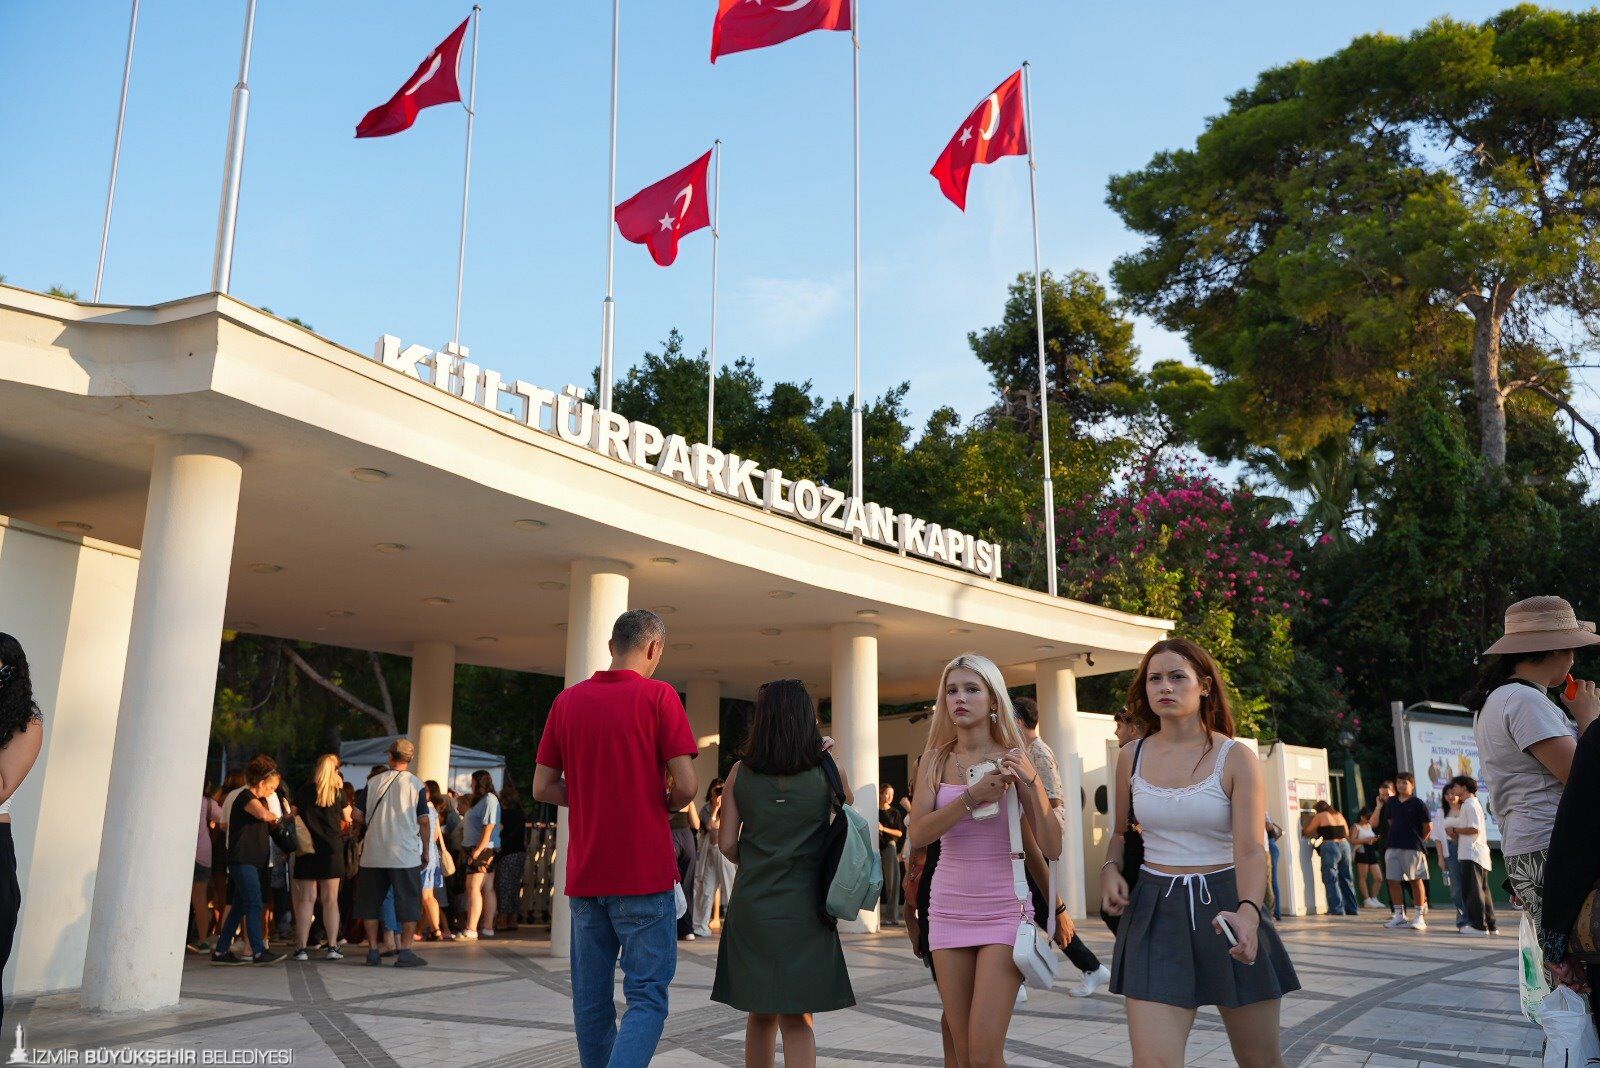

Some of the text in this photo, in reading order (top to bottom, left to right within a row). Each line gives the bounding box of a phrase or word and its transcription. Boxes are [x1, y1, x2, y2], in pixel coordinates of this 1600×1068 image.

[376, 333, 1002, 579] KÜLTÜRPARK LOZAN KAPISI
